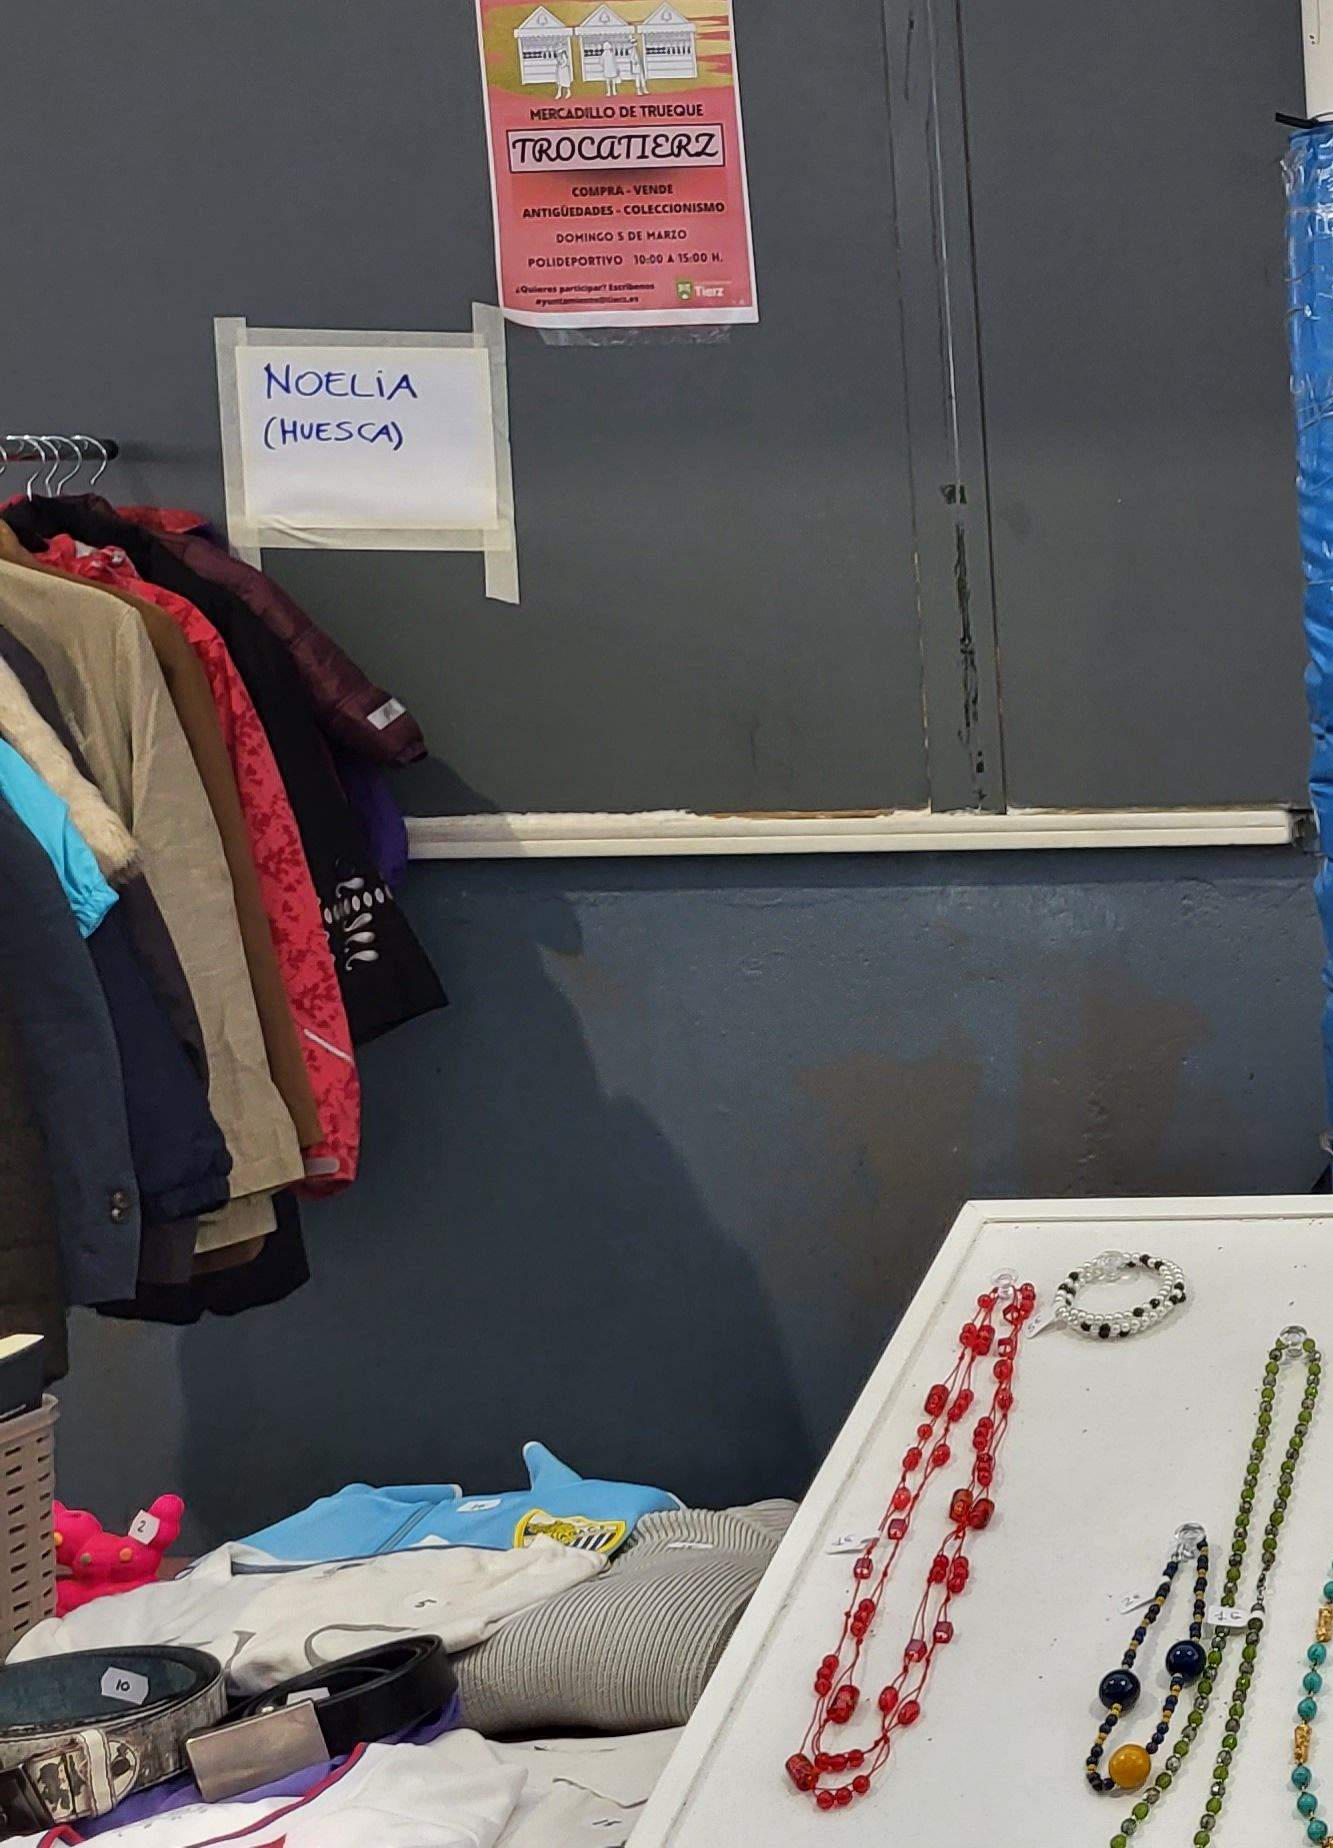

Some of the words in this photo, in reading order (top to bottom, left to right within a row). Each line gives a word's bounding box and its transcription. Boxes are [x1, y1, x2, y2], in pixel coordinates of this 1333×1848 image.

[530, 106, 615, 120] MERCADILLO
[619, 106, 637, 118] DE
[639, 104, 703, 118] TRUEQUE
[511, 131, 719, 164] TROCATIERZ
[571, 186, 625, 198] COMPRA
[633, 184, 673, 196] VENDE
[522, 204, 613, 219] ANTIGÜEDADES
[623, 202, 725, 216] COLECCIONISMO
[556, 232, 614, 243] DOMINGO
[617, 232, 625, 242] 5
[628, 231, 643, 241] DE
[646, 229, 687, 241] MARZO
[528, 255, 623, 268] POLIDEPORTIVO
[633, 254, 663, 265] 10:00
[667, 254, 674, 263] A
[678, 252, 708, 263] 15:00
[711, 252, 723, 262] H.
[263, 416, 403, 451] (HUESCA)
[137, 1520, 147, 1533] 2
[115, 1678, 131, 1692] 10
